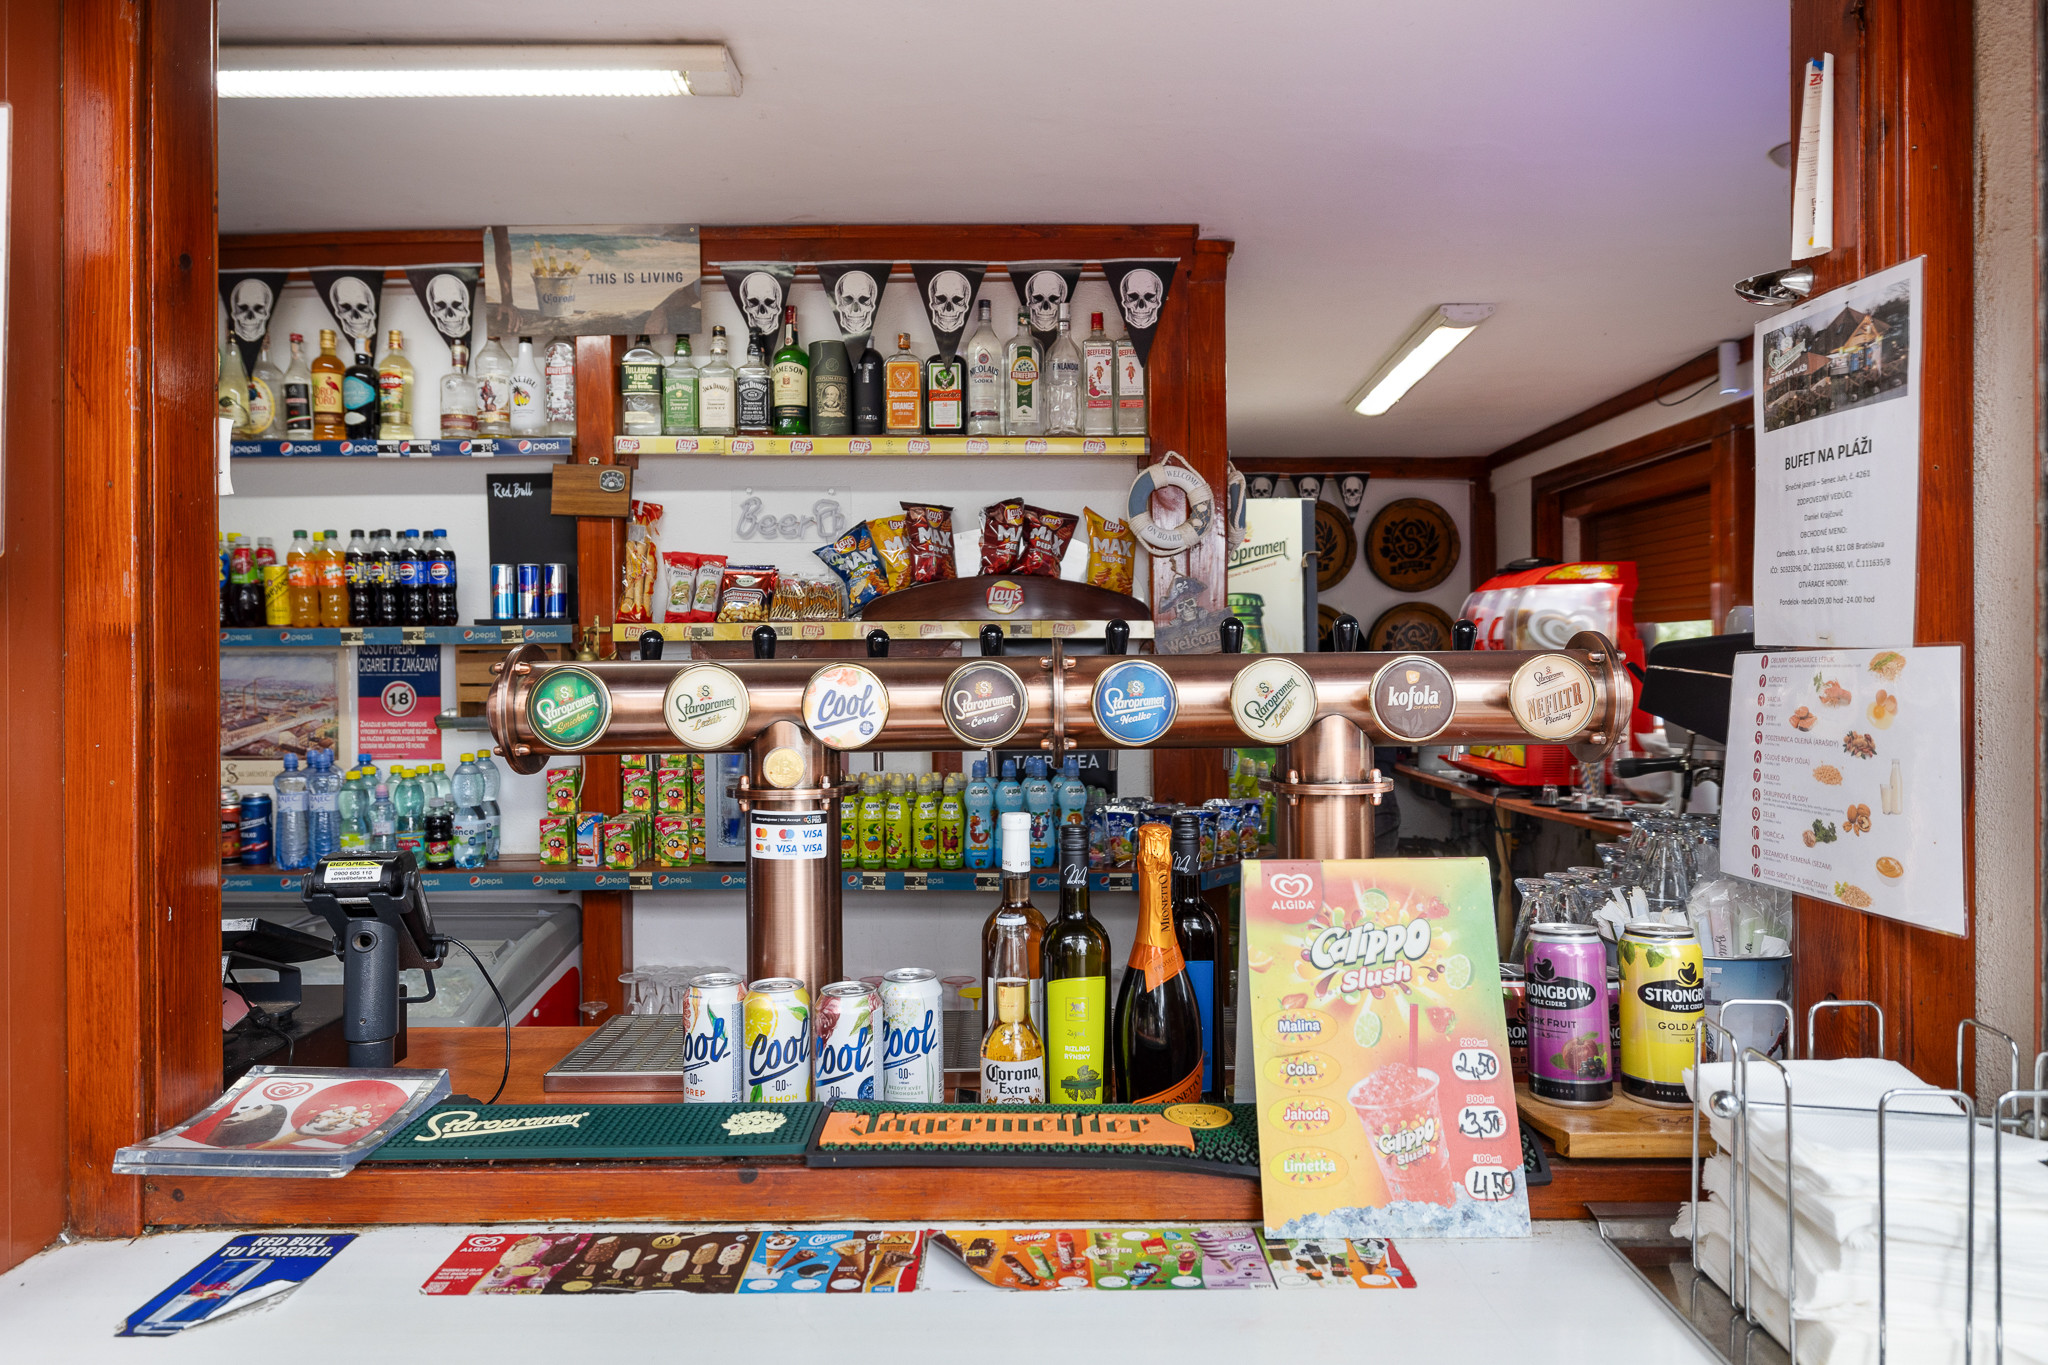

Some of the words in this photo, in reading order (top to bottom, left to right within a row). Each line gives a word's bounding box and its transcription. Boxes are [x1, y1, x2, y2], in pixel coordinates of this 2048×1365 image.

[588, 273, 617, 285] THIS
[624, 272, 634, 283] IS
[641, 271, 683, 284] LIVING
[1087, 349, 1111, 357] BEEFEATER
[625, 365, 657, 375] TULLAMORE
[773, 365, 803, 376] JAMESON
[969, 365, 999, 377] NICOLAUS
[1052, 361, 1079, 371] FINLANDIA
[892, 402, 914, 410] ORANGE
[235, 444, 261, 456] pepsi
[533, 442, 560, 454] pepsi
[1785, 452, 1815, 471] BUFET
[1818, 447, 1835, 463] NA
[1838, 436, 1873, 459] PLÁŽI
[1166, 470, 1200, 488] WELCOME
[1821, 477, 1836, 485] Senec
[1856, 470, 1871, 478] 4261
[493, 483, 512, 498] Red
[513, 482, 532, 498] Bull
[1797, 494, 1830, 506] ZODPOVEDNÝ
[1831, 490, 1854, 501] VEDÚCI:
[736, 497, 814, 540] Beer
[1804, 513, 1819, 522] Daniel
[918, 527, 952, 548] MAX
[1147, 525, 1157, 536] ON
[1157, 533, 1182, 542] BOARD
[1800, 529, 1828, 539] OBCHODNÉ
[1828, 527, 1848, 535] MENO:
[1093, 537, 1132, 557] MAX
[1836, 544, 1846, 552] 821
[1847, 543, 1855, 551] 08
[1856, 541, 1885, 550] Bratislava
[844, 548, 878, 573] MAX
[1101, 556, 1127, 565] DEEP-CUT
[1798, 580, 1825, 589] OTVÁRACIE
[1826, 580, 1849, 588] HODINY:
[988, 587, 1023, 608] Lay's
[1833, 596, 1843, 604] hod
[1863, 595, 1875, 603] hod
[291, 634, 313, 642] pepsi
[536, 631, 558, 640] pepsi
[359, 657, 391, 672] CIGARIET
[392, 657, 400, 672] JE
[401, 654, 439, 672] ZAKÁZANÝ
[389, 692, 408, 705] 18
[1105, 687, 1167, 717] Staropramen
[1244, 677, 1302, 729] Staropramen
[1388, 685, 1439, 711] kofola
[1527, 682, 1583, 722] NEFILTR
[536, 694, 600, 729] Staropramen
[676, 693, 737, 723] Staropramen
[953, 690, 1016, 720] Staropramen
[1413, 704, 1441, 713] original
[971, 713, 999, 728] Černý
[1120, 711, 1152, 725] Nealko
[1766, 714, 1776, 722] RYBY
[1765, 733, 1794, 744] PODZEMNICA
[1795, 736, 1813, 745] OLEJNÁ
[1813, 737, 1839, 748] (ARAŠIDY)
[1763, 773, 1780, 782] MLIEKO
[1763, 789, 1791, 801] ŠKRUPINOVÉ
[1791, 793, 1809, 803] PLODY
[1763, 811, 1777, 819] ZELER
[577, 818, 595, 834] Relax
[803, 829, 823, 838] VISA
[1763, 830, 1785, 841] HORČICA
[776, 844, 797, 853] VISA
[803, 843, 823, 852] VISA
[1763, 848, 1789, 861] SEZAMOVÉ
[1789, 852, 1812, 866] SEMENÁ
[1812, 859, 1833, 872] (SEZAM)
[482, 877, 503, 886] pepsi
[1763, 868, 1776, 877] OXID
[1776, 870, 1795, 882] SIRIČITÝ
[1801, 877, 1829, 890] SIRIČITANY
[1160, 869, 1171, 933] MIONETTO
[1272, 900, 1314, 910] ALGIDA
[1311, 918, 1431, 969] Calippo
[1342, 960, 1412, 992] Slush
[1645, 987, 1704, 1003] STRONGB
[1545, 999, 1567, 1008] CIDERS
[1278, 1019, 1321, 1033] Malina
[1527, 1015, 1545, 1026] DARK
[1547, 1018, 1577, 1029] FRUIT
[1658, 1021, 1688, 1031] GOLD
[1461, 1038, 1477, 1047] 200
[1064, 1052, 1091, 1060] RÝNSKY
[1287, 1063, 1317, 1076] Cola
[1455, 1052, 1496, 1080] 2,50
[986, 1064, 1041, 1085] Corona
[685, 1087, 706, 1097] GREP
[999, 1082, 1030, 1095] Extra
[764, 1093, 798, 1104] LEMON
[1466, 1095, 1484, 1104] 300
[1485, 1096, 1494, 1104] ml
[1284, 1108, 1329, 1122] Jahoda
[414, 1110, 590, 1142] Staropramen
[1459, 1108, 1501, 1139] 3,50
[1378, 1117, 1435, 1154] Calippo
[1284, 1159, 1336, 1173] Limetka
[1492, 1155, 1501, 1164] ml
[1473, 1171, 1515, 1202] 4,50
[251, 1236, 287, 1247] RED
[288, 1236, 327, 1247] BULL
[809, 1234, 847, 1245] Cornetto
[1014, 1232, 1051, 1242] Calippo
[220, 1246, 245, 1257] TU
[247, 1246, 261, 1257] V
[262, 1246, 332, 1257] PREDAJI.
